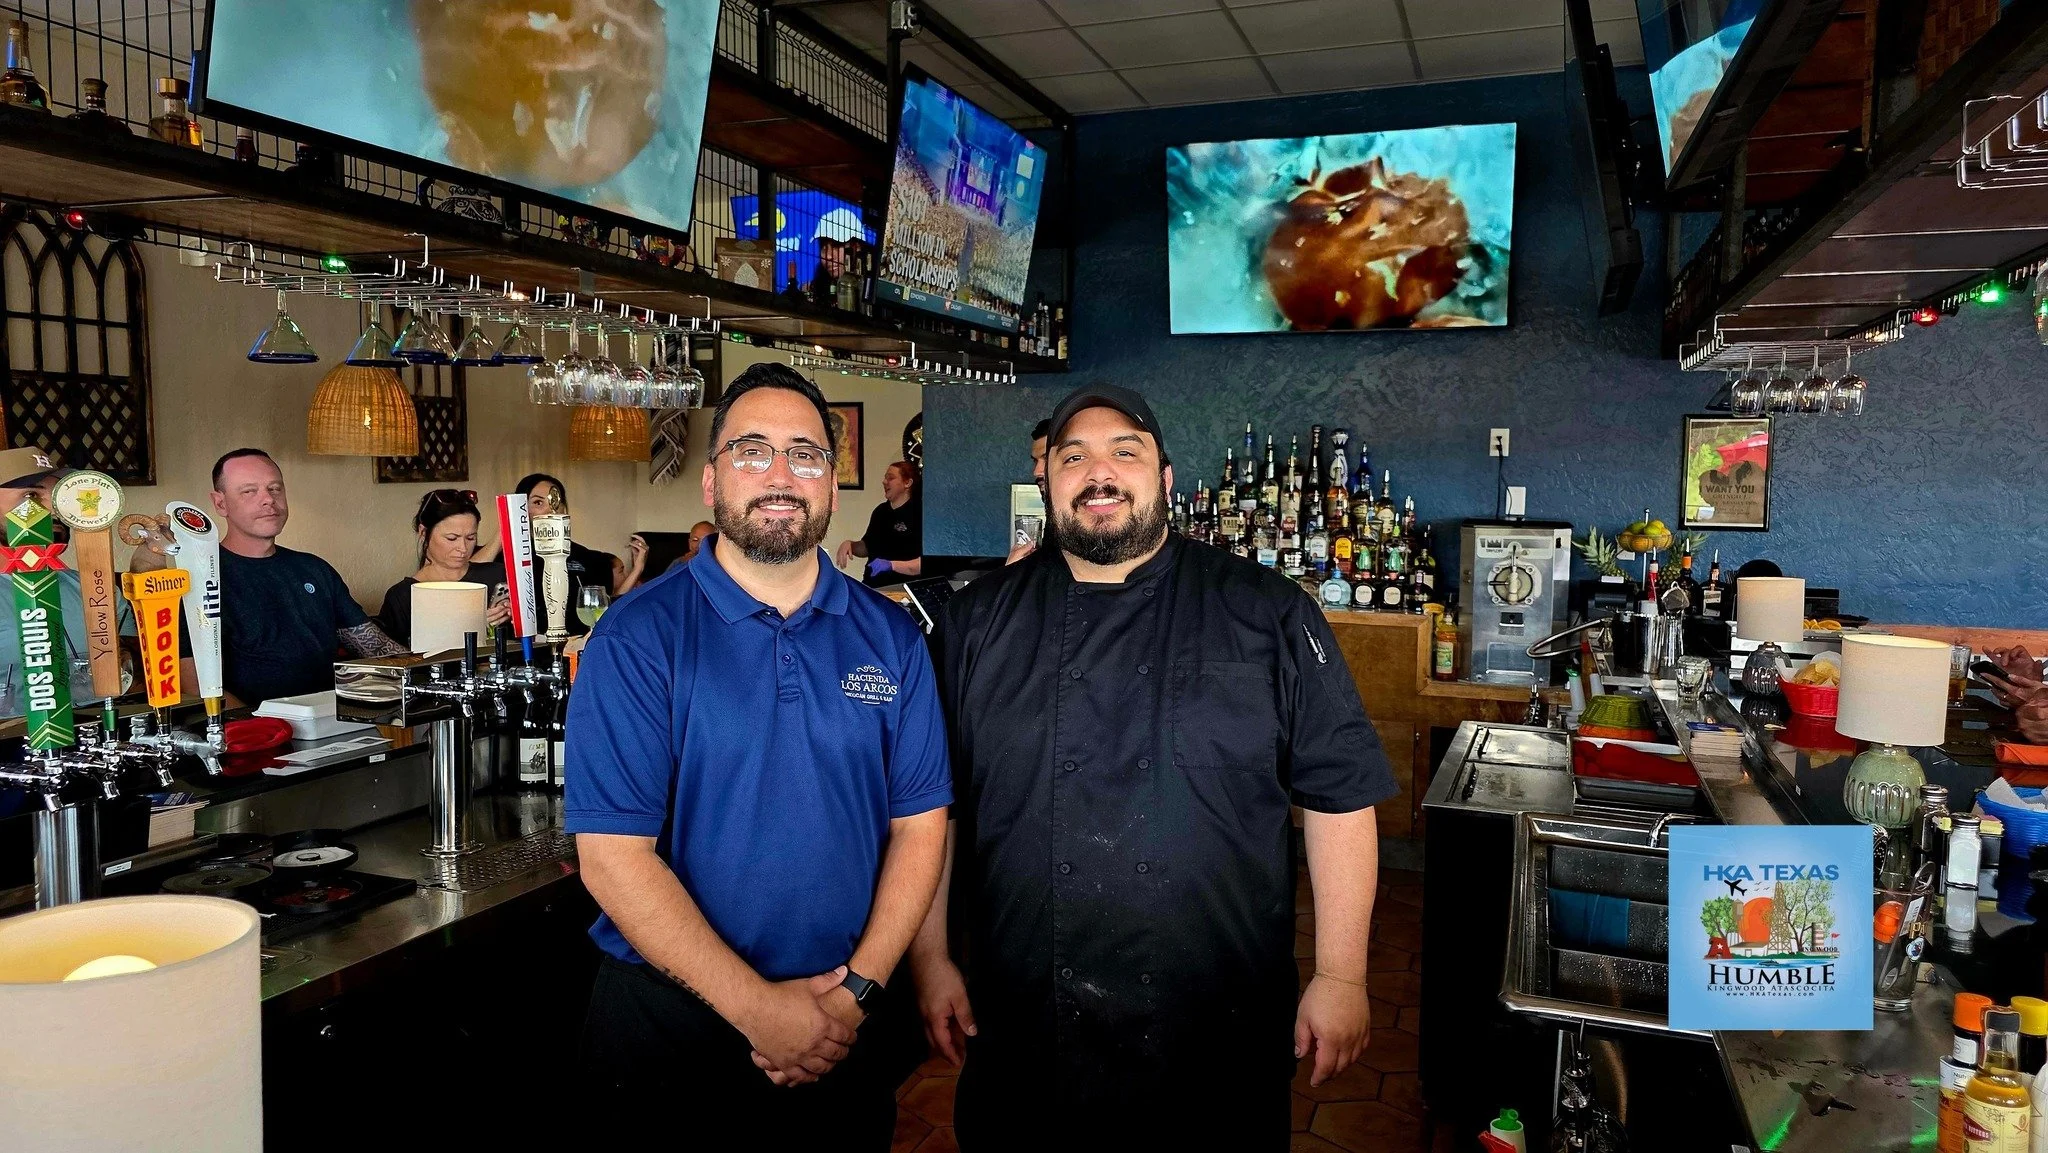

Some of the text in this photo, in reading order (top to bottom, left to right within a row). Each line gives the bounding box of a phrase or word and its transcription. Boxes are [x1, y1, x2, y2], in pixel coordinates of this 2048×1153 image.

[894, 222, 935, 255] MILLION
[890, 250, 958, 291] SCHOLARSHIPS
[65, 477, 111, 491] Lone Pint
[1705, 485, 1733, 494] WANT
[1735, 485, 1755, 494] YOU
[67, 511, 110, 525] Brewery
[520, 502, 530, 556] ULTRA
[534, 526, 560, 538] Modelo
[144, 576, 185, 595] Shiner
[89, 569, 113, 660] Yellow Rose
[20, 607, 57, 712] DOS EQUIS
[156, 607, 177, 699] BOCK
[841, 680, 898, 695] LOS ARCOS
[848, 674, 889, 684] HACIENDA
